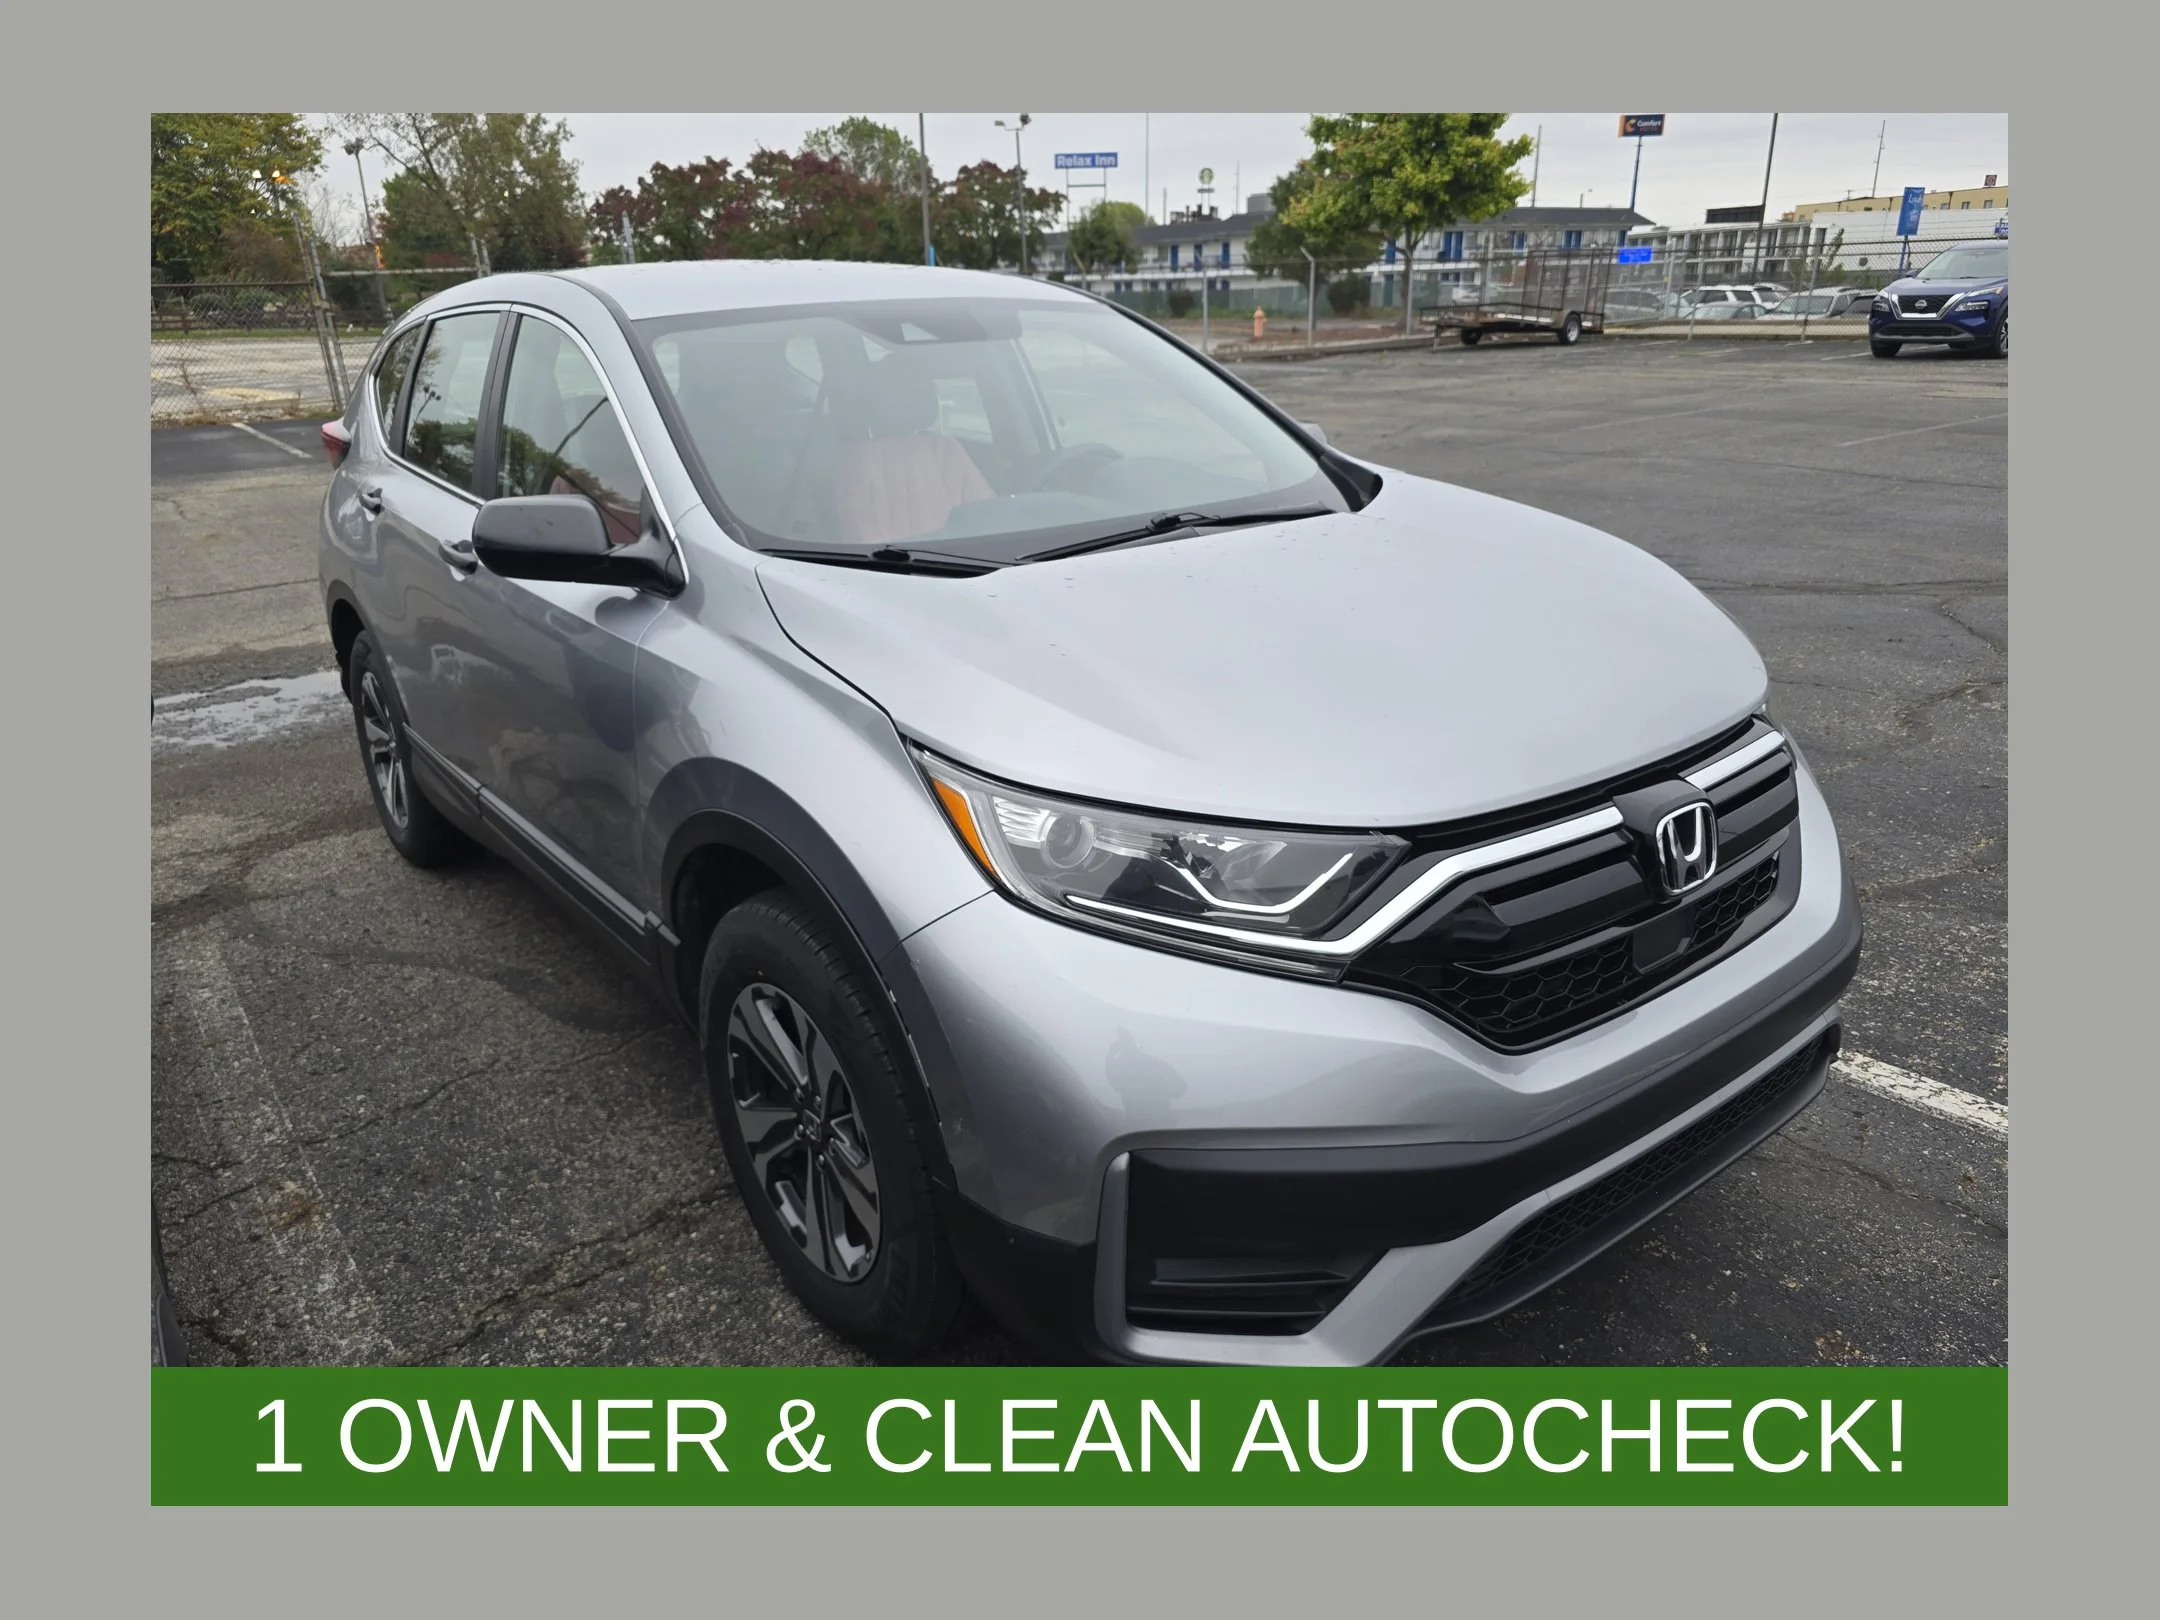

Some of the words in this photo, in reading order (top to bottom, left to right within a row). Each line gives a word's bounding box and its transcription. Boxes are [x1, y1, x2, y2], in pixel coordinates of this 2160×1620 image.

[1637, 119, 1662, 127] Comfort
[1056, 155, 1092, 168] Relax
[1095, 154, 1116, 167] Inn
